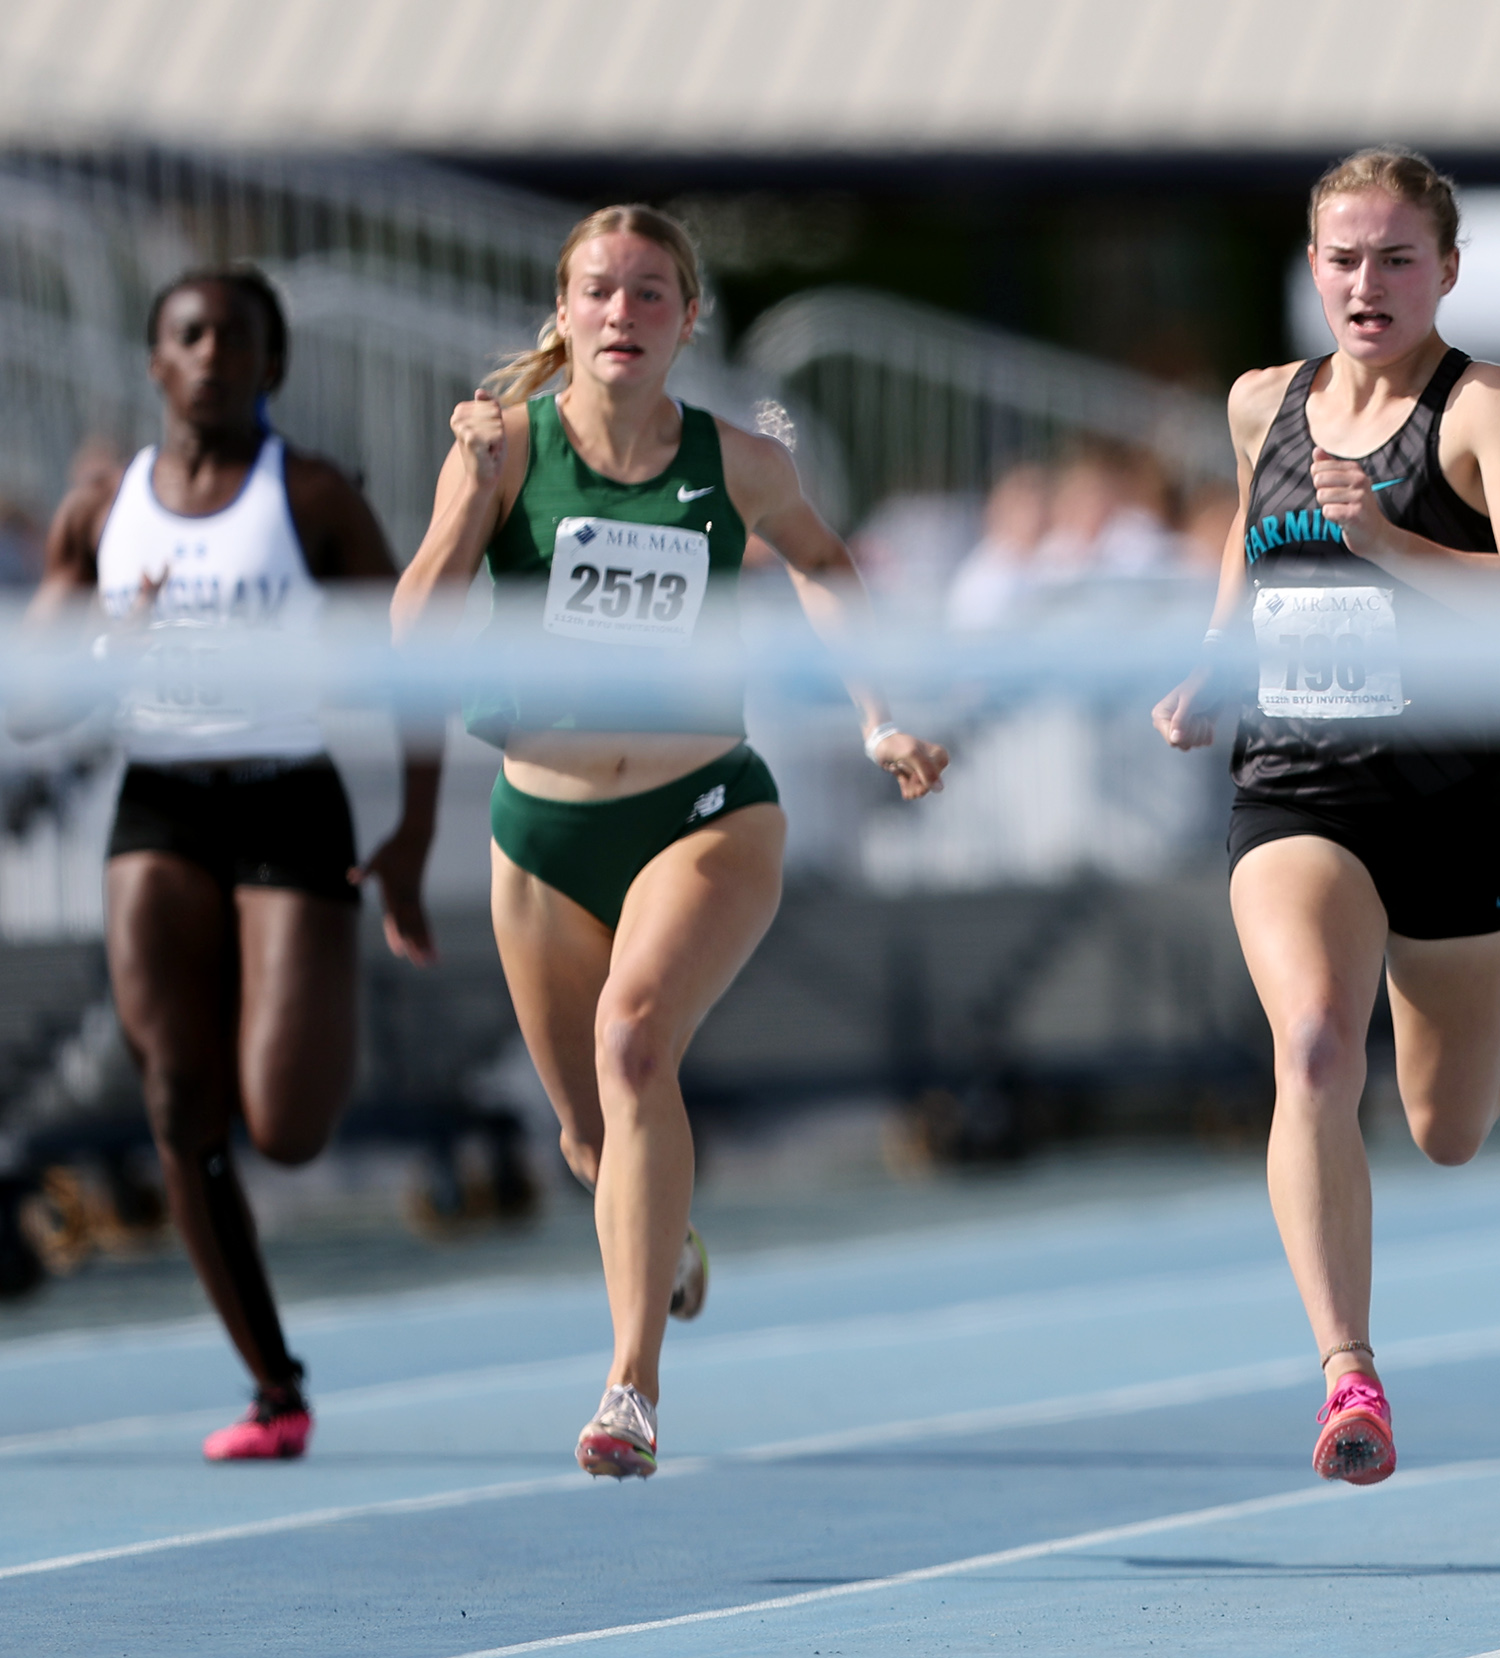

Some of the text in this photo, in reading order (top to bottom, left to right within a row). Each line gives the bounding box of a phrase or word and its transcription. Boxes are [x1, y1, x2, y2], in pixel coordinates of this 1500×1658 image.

[1245, 508, 1342, 565] ARMIN
[565, 563, 687, 622] 2513
[1292, 696, 1313, 704] BYU
[1316, 694, 1393, 704] INVITATIONAL
